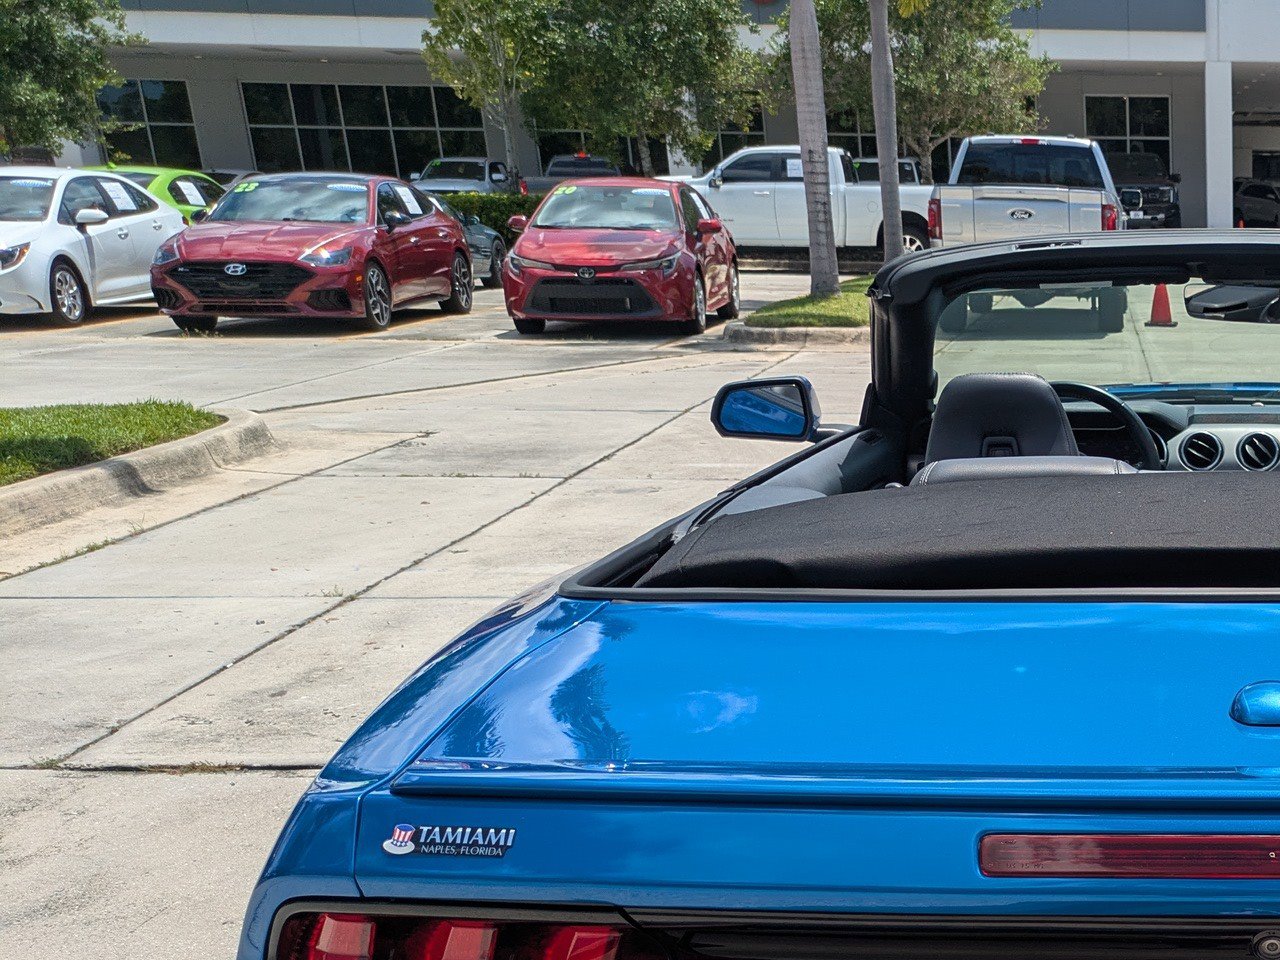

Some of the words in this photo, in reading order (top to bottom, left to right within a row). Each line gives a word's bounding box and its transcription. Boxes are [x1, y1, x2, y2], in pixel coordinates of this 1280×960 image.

[553, 185, 577, 195] 20
[419, 825, 516, 846] TAMIAMI
[421, 844, 457, 856] NAPLES,
[459, 846, 503, 857] FLORIDA
